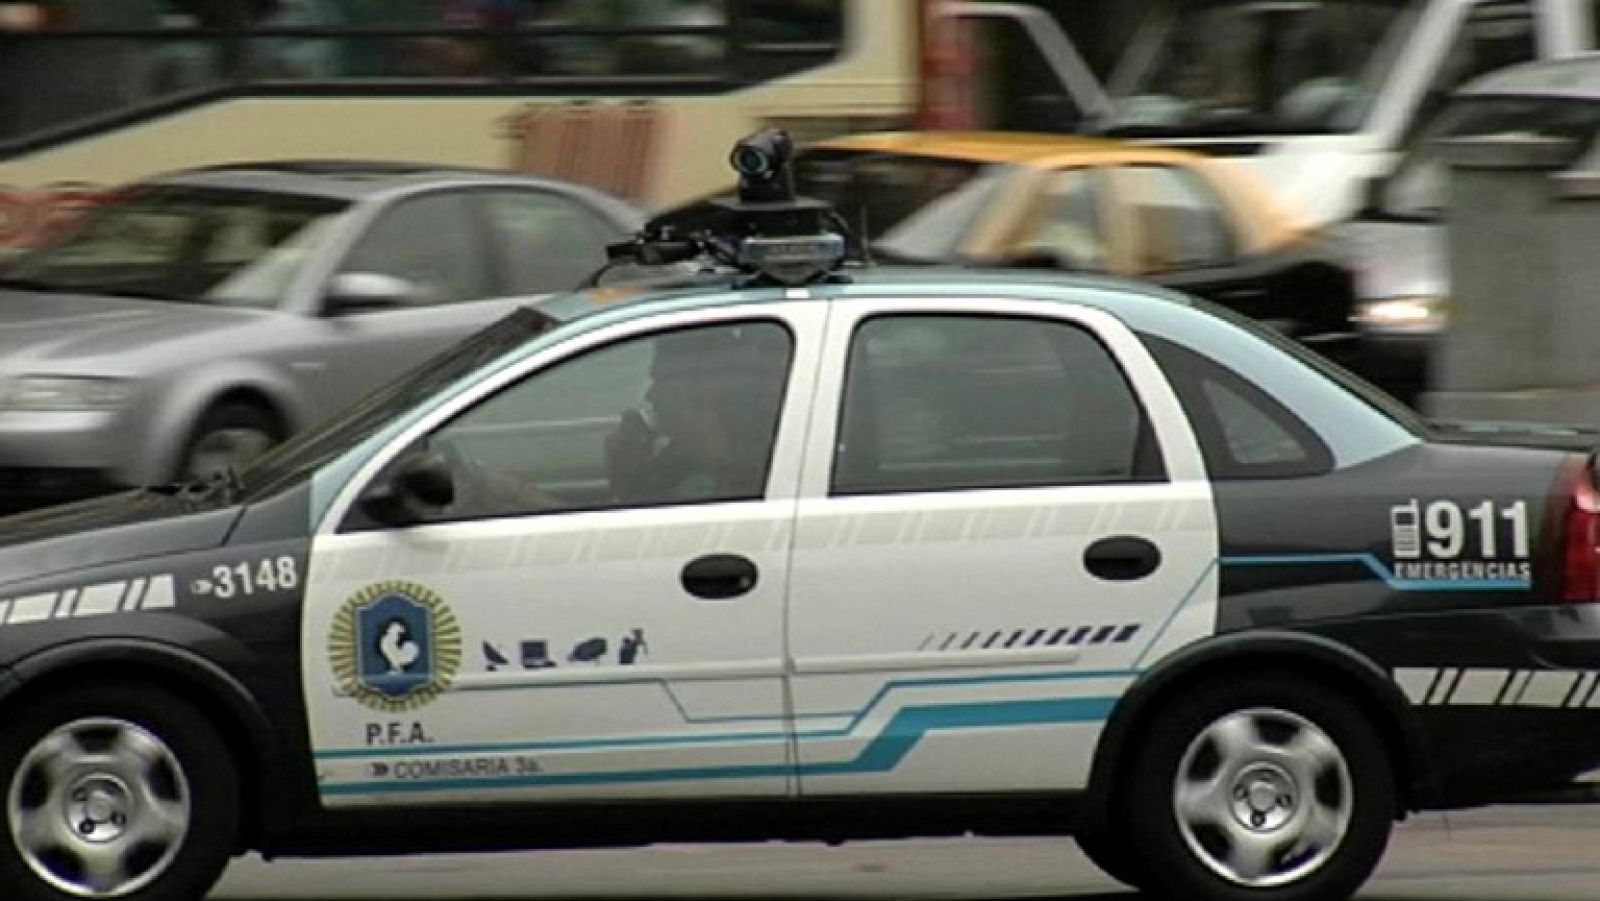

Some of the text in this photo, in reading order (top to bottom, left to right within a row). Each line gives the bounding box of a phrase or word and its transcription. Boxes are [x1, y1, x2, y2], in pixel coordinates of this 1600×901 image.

[1425, 499, 1529, 559] 911
[212, 556, 298, 598] 3148
[1393, 561, 1532, 580] EMERGENCIAS
[394, 757, 510, 779] COMISARIA
